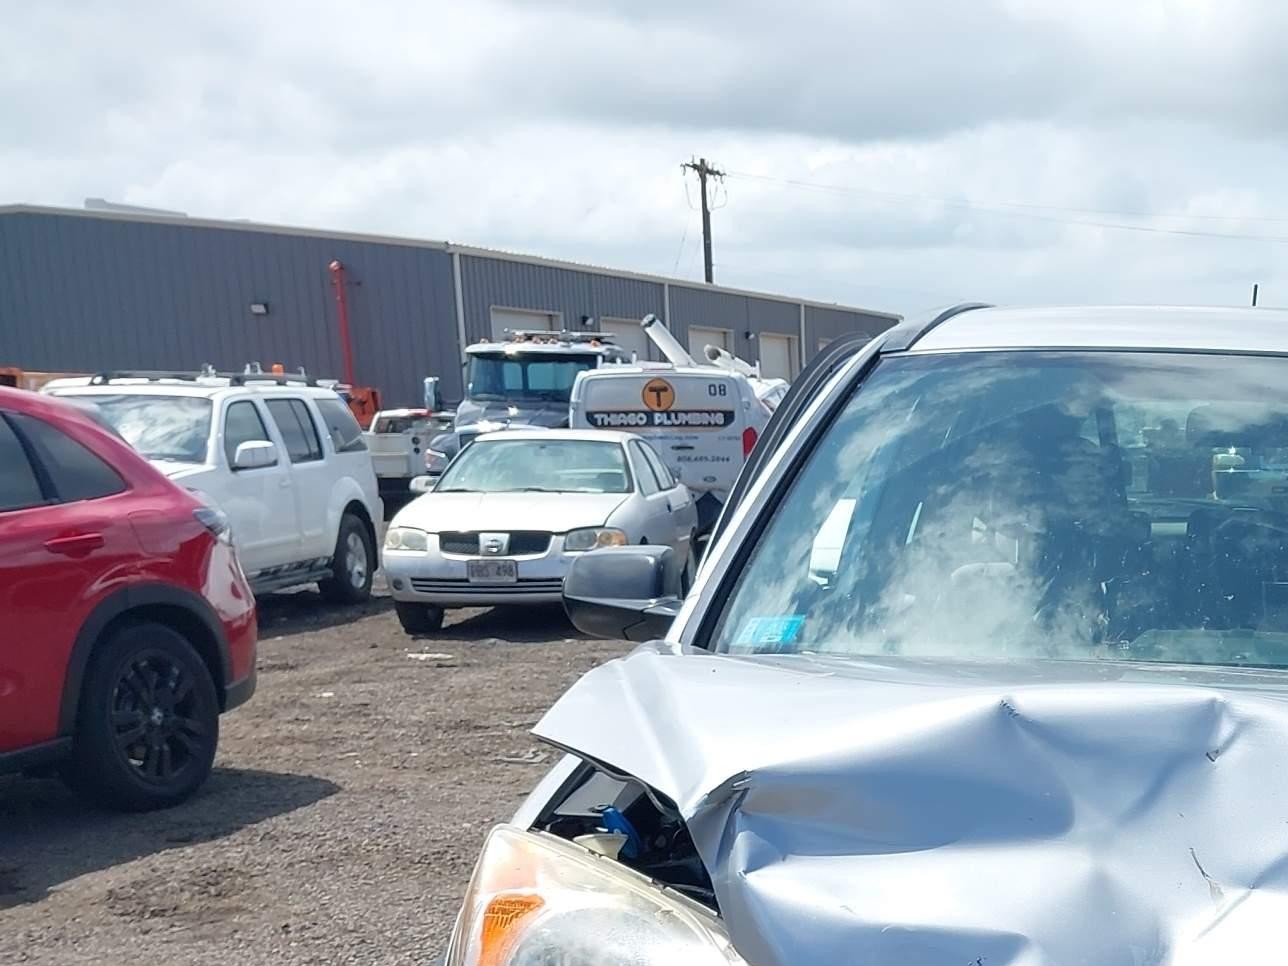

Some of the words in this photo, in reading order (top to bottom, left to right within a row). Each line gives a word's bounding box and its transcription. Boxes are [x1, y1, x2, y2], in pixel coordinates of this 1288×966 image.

[648, 386, 668, 408] T
[708, 384, 727, 397] 08
[593, 412, 647, 426] THIAGO
[653, 412, 725, 426] PLUMBING
